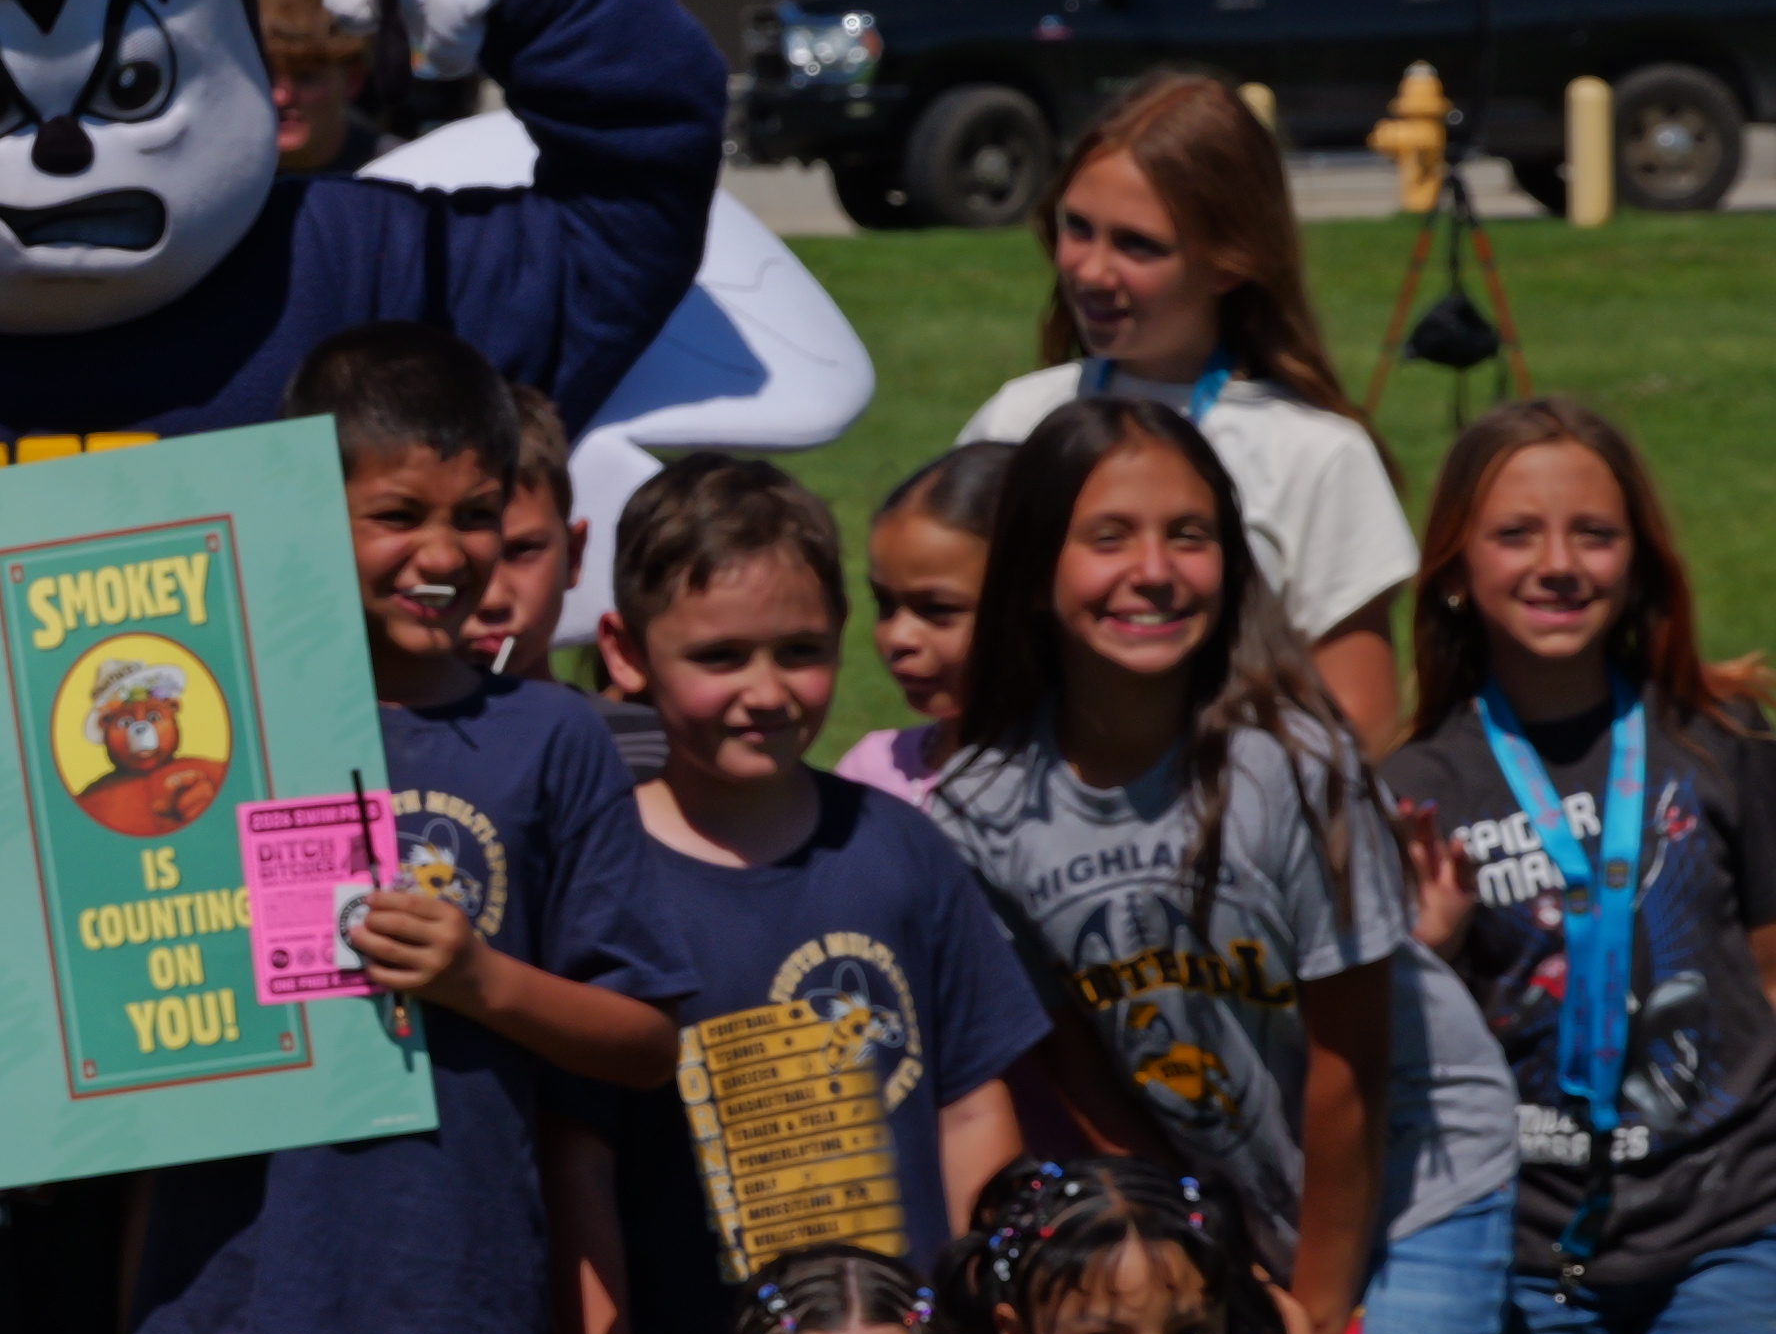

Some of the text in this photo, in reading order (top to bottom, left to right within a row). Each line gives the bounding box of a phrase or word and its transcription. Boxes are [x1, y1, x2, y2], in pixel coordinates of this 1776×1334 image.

[27, 552, 209, 651] SMOKEY
[339, 801, 379, 822] PAS
[1451, 791, 1601, 865] SPIDR
[142, 846, 179, 891] IS
[78, 892, 252, 949] COUNTING
[149, 943, 204, 990] ON
[126, 987, 240, 1052] YOU!
